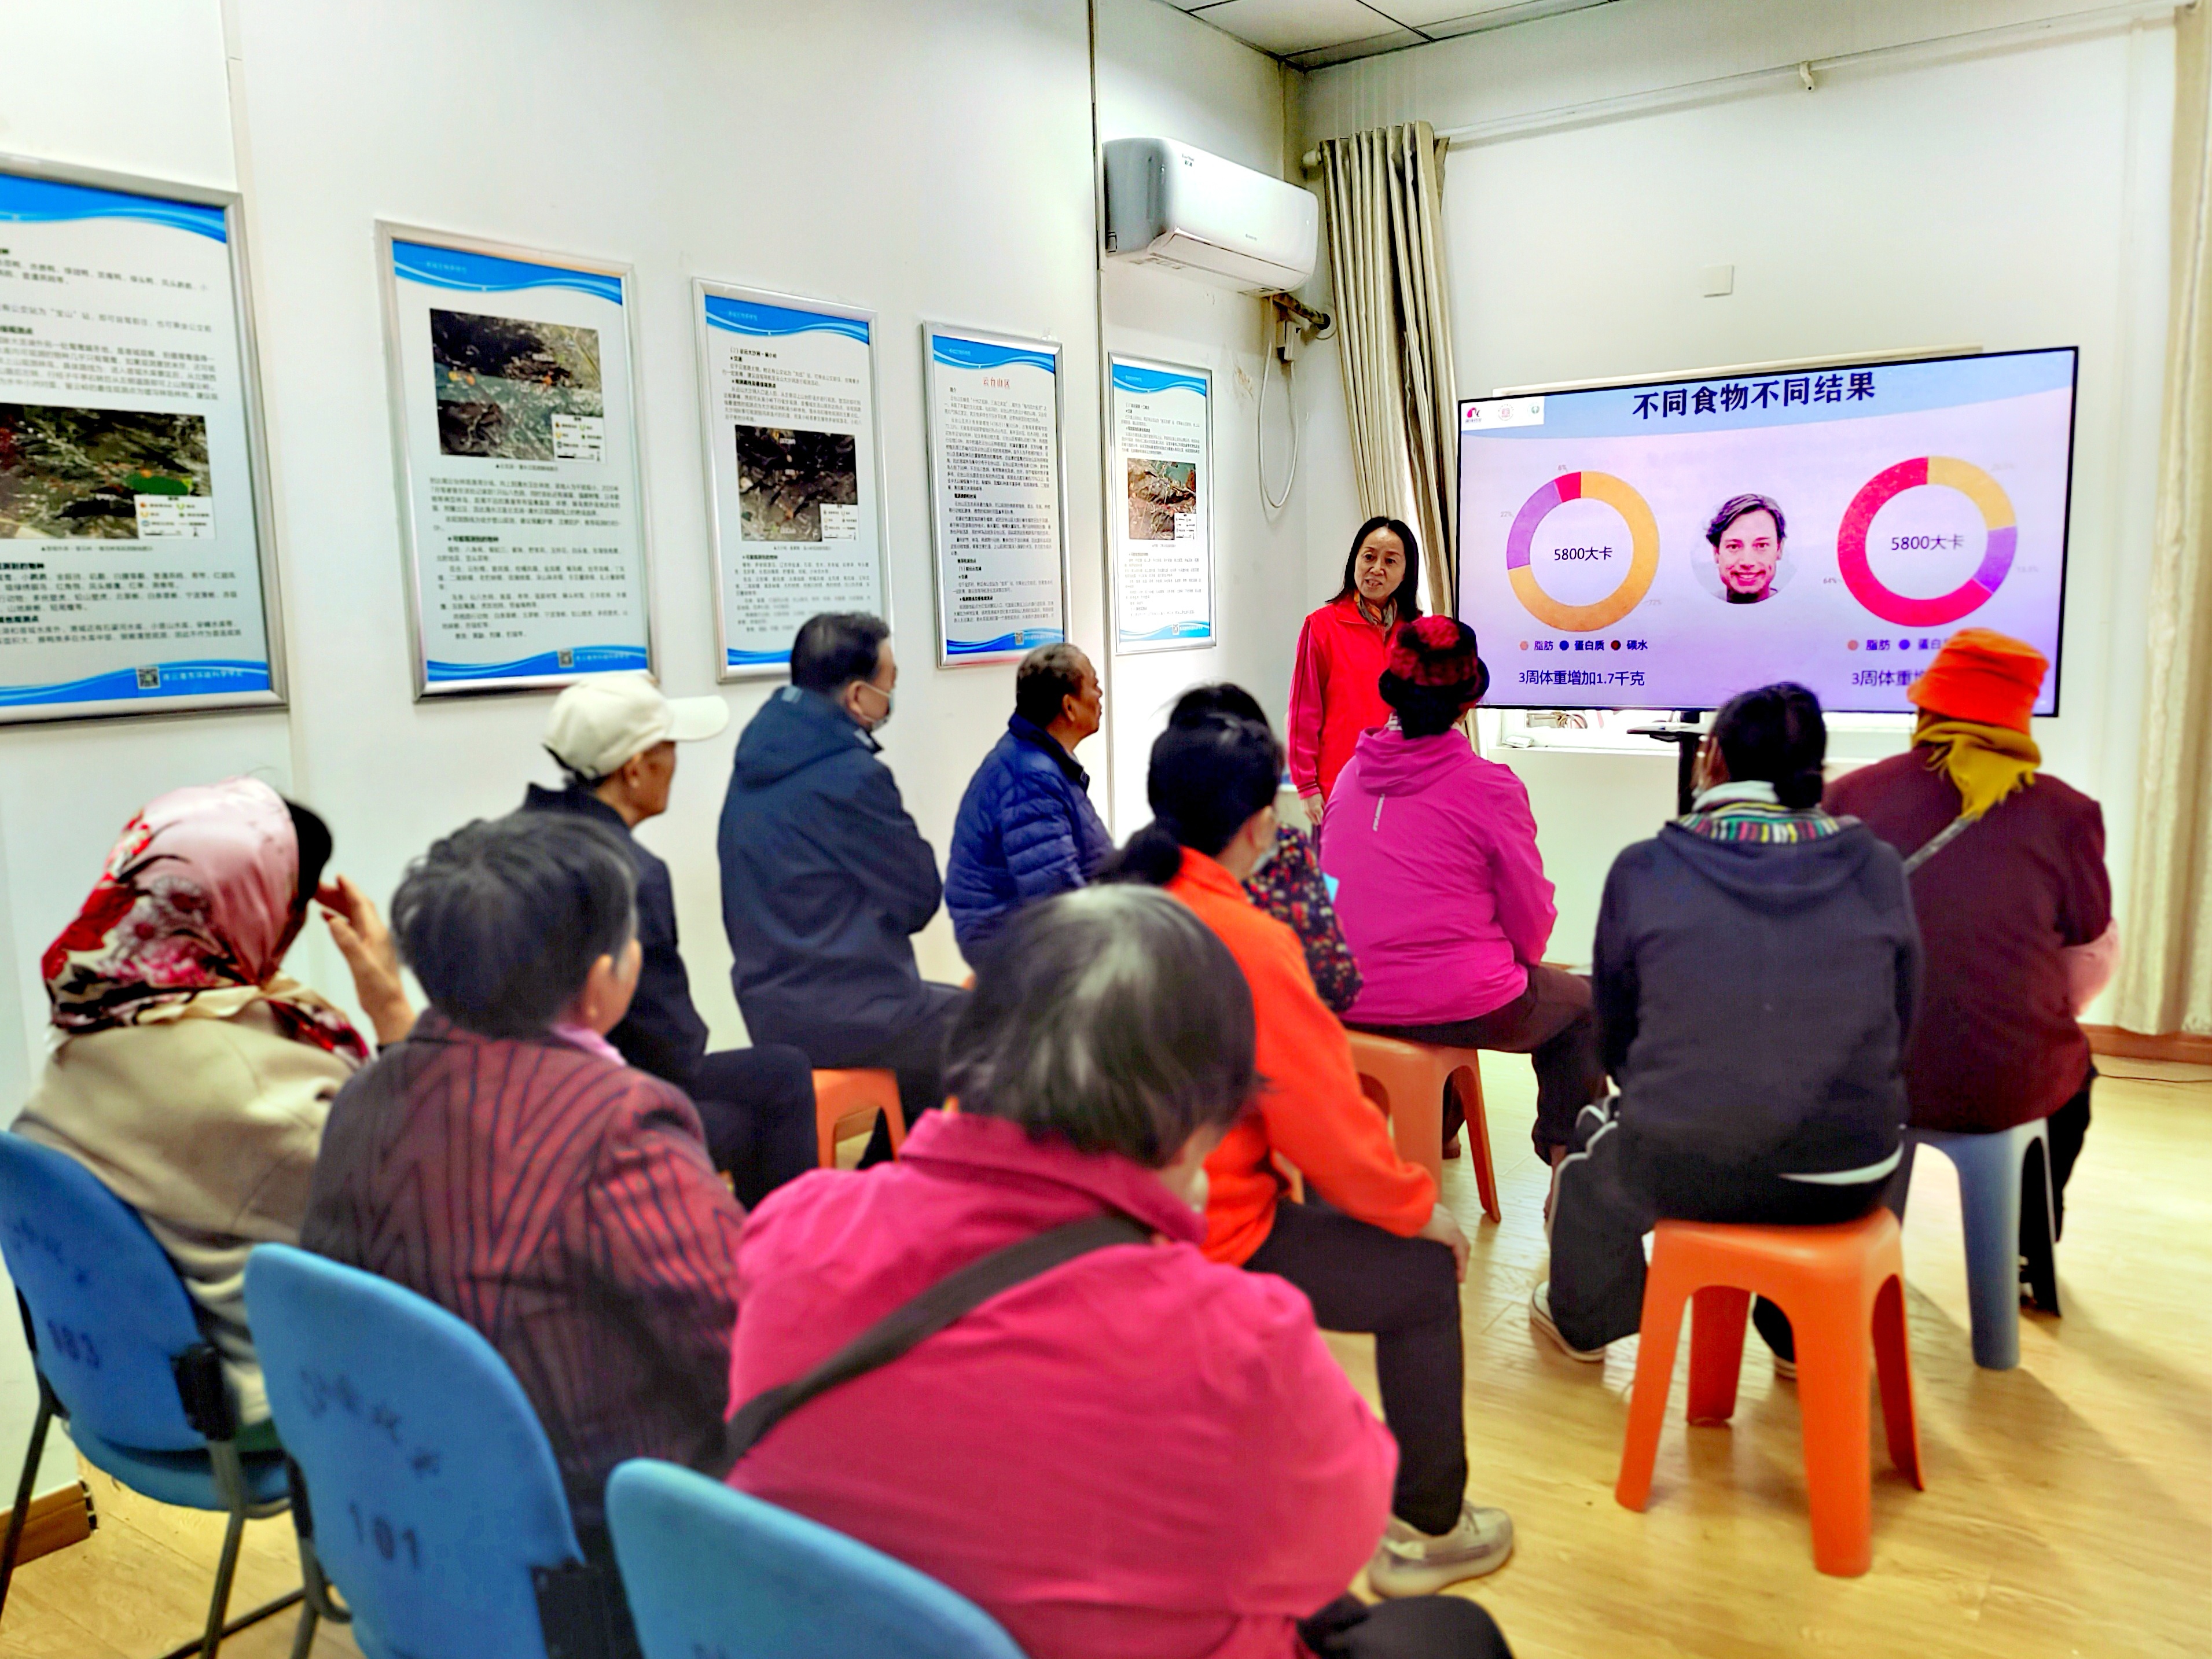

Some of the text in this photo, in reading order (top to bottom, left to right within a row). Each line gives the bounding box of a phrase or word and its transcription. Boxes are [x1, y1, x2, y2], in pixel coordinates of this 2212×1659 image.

[983, 377, 1010, 389] 云台山区
[1633, 371, 1875, 419] 不同食物不同结果
[1891, 534, 1965, 550] 5800大卡
[1554, 546, 1612, 561] 5800大卡
[1534, 639, 1648, 651] 脂肪 蛋白质 碳水
[1866, 638, 1948, 651] 脂肪 蛋白
[1519, 670, 1645, 686] 3周体重增加1.7千克
